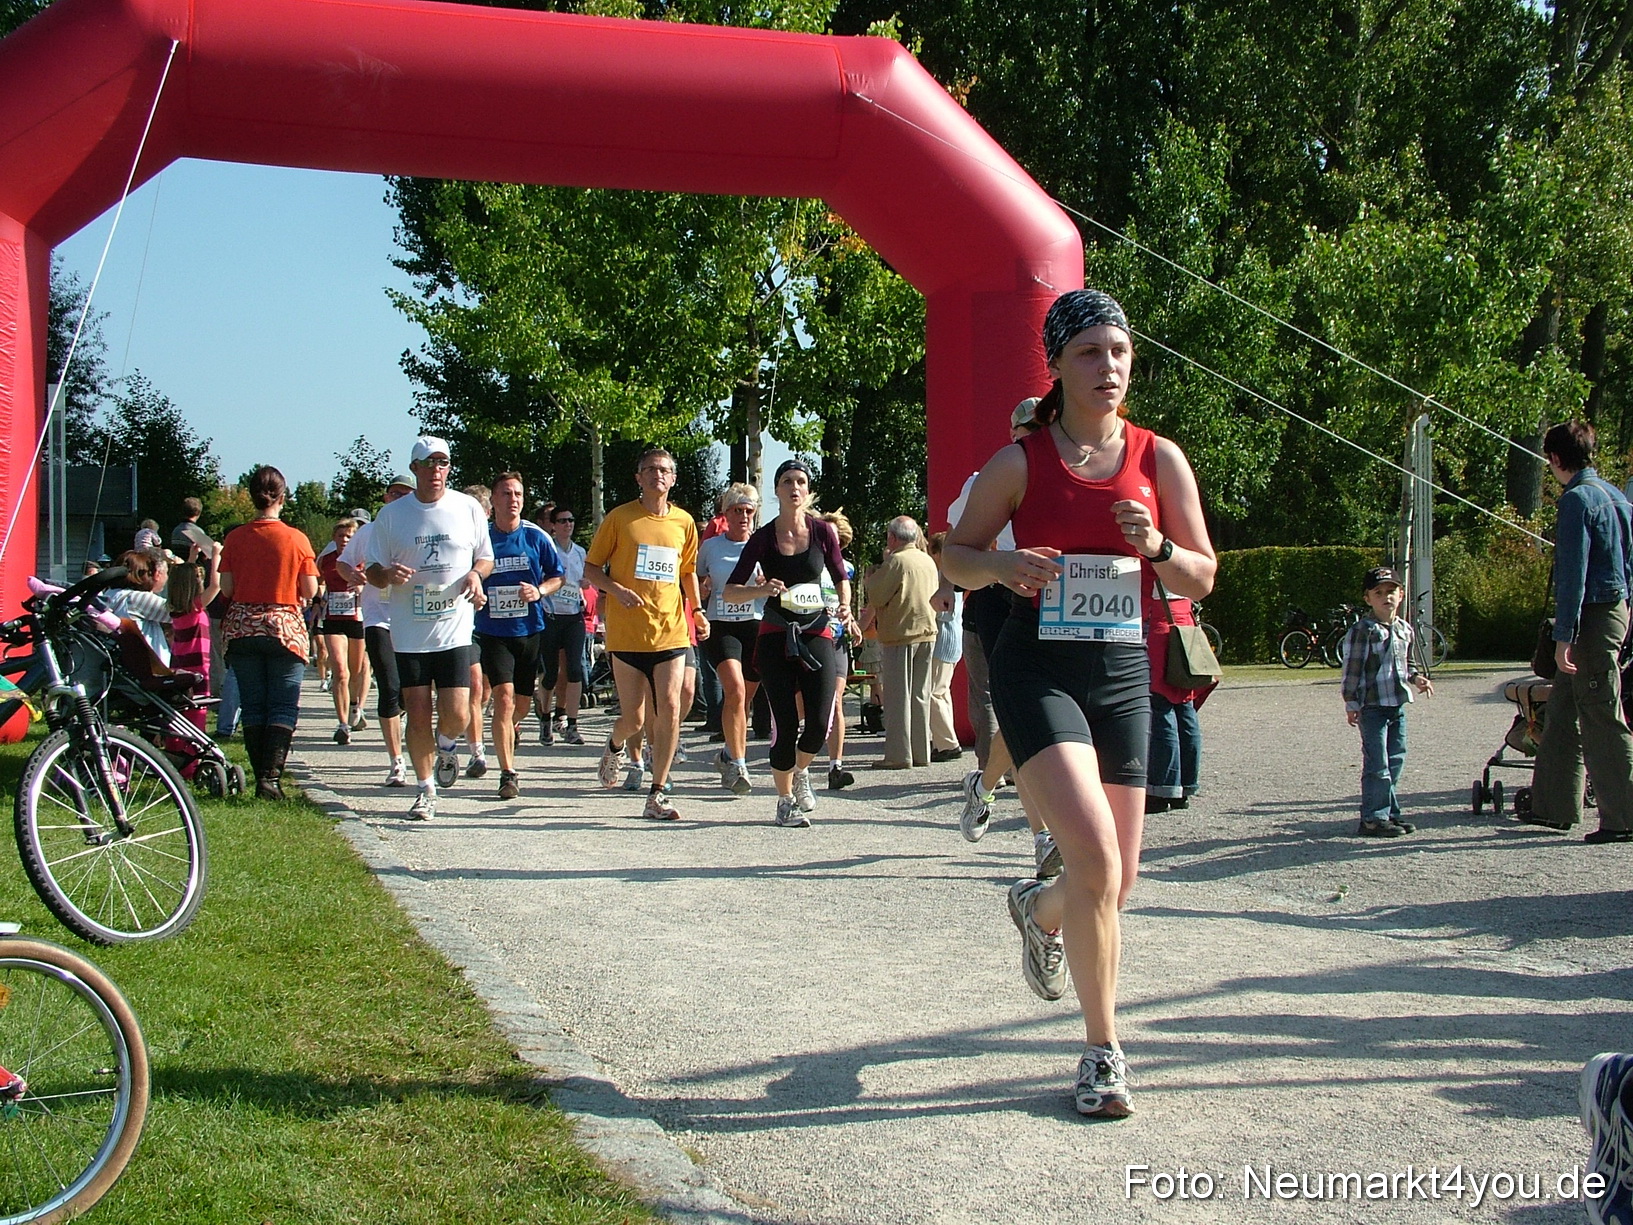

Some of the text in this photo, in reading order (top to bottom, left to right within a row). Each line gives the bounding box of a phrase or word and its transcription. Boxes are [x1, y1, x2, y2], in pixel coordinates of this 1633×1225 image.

[495, 556, 529, 568] UBER
[648, 560, 674, 573] 3565
[1070, 562, 1118, 580] Christa
[500, 600, 525, 609] 2479
[795, 594, 818, 603] 1040
[427, 598, 454, 612] 2013
[727, 603, 752, 613] 2347
[1071, 593, 1134, 618] 2040
[1040, 627, 1080, 635] BOCK
